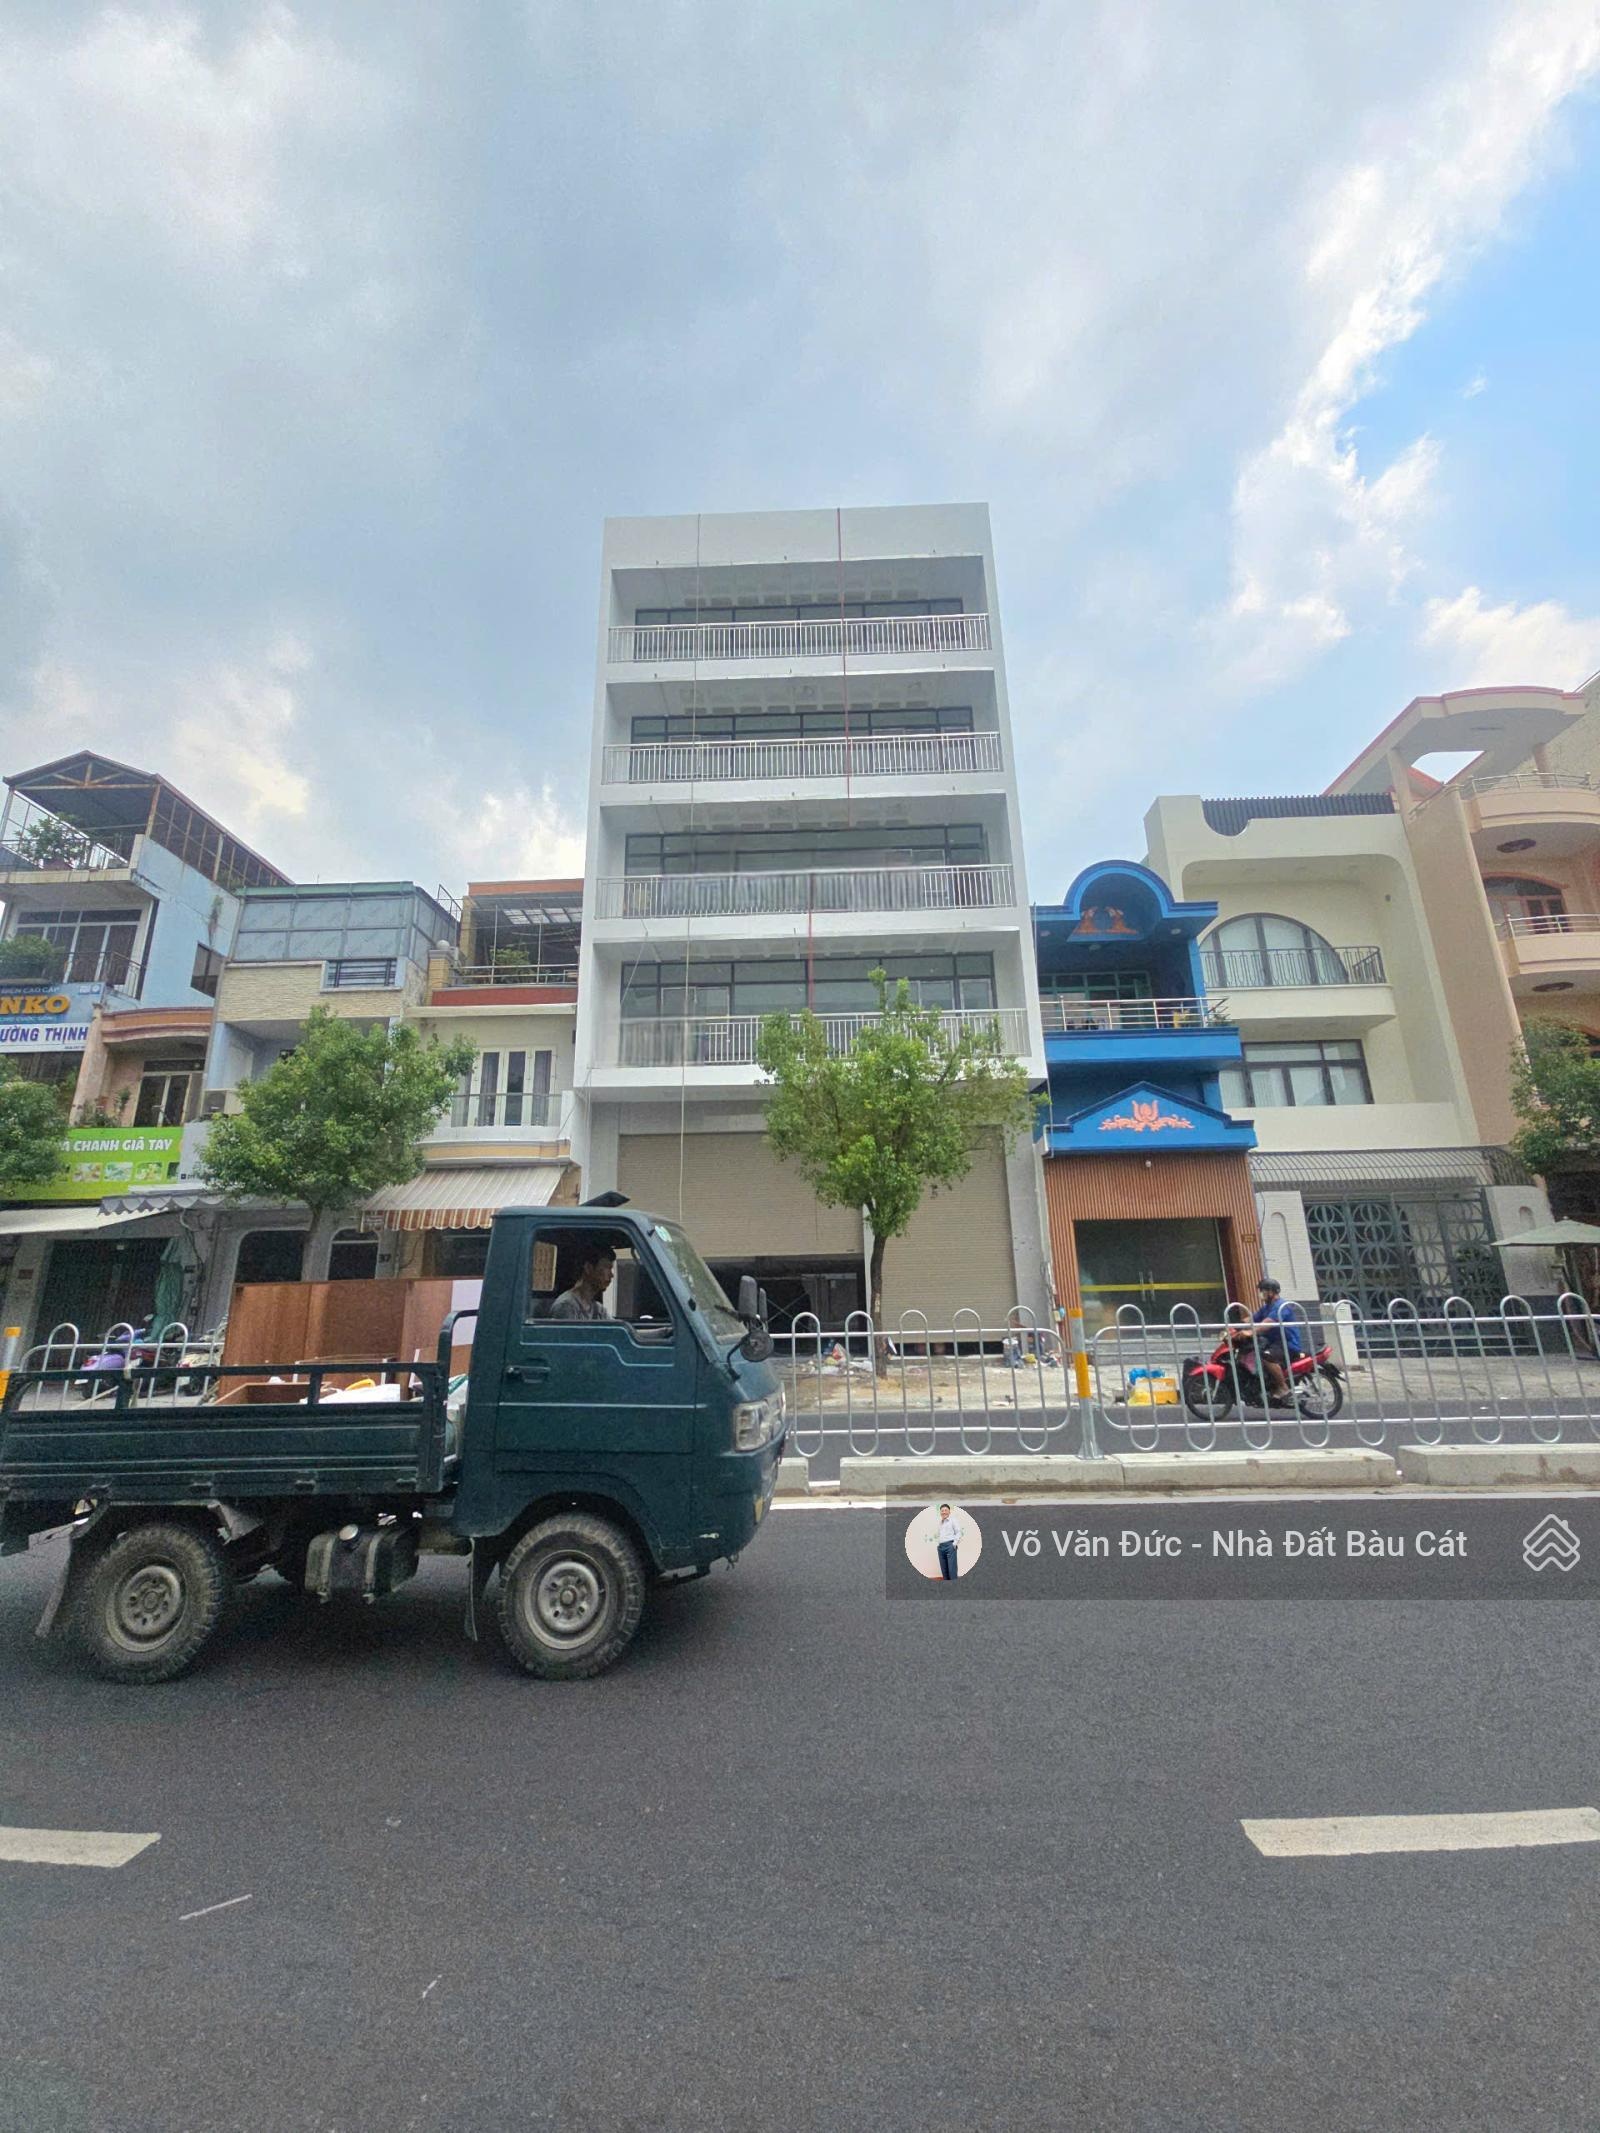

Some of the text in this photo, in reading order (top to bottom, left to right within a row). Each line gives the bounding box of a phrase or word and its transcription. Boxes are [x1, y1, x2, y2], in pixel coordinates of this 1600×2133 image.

[45, 1026, 88, 1044] THỊNH
[73, 1140, 119, 1152] CHANH
[149, 1139, 173, 1151] TAY
